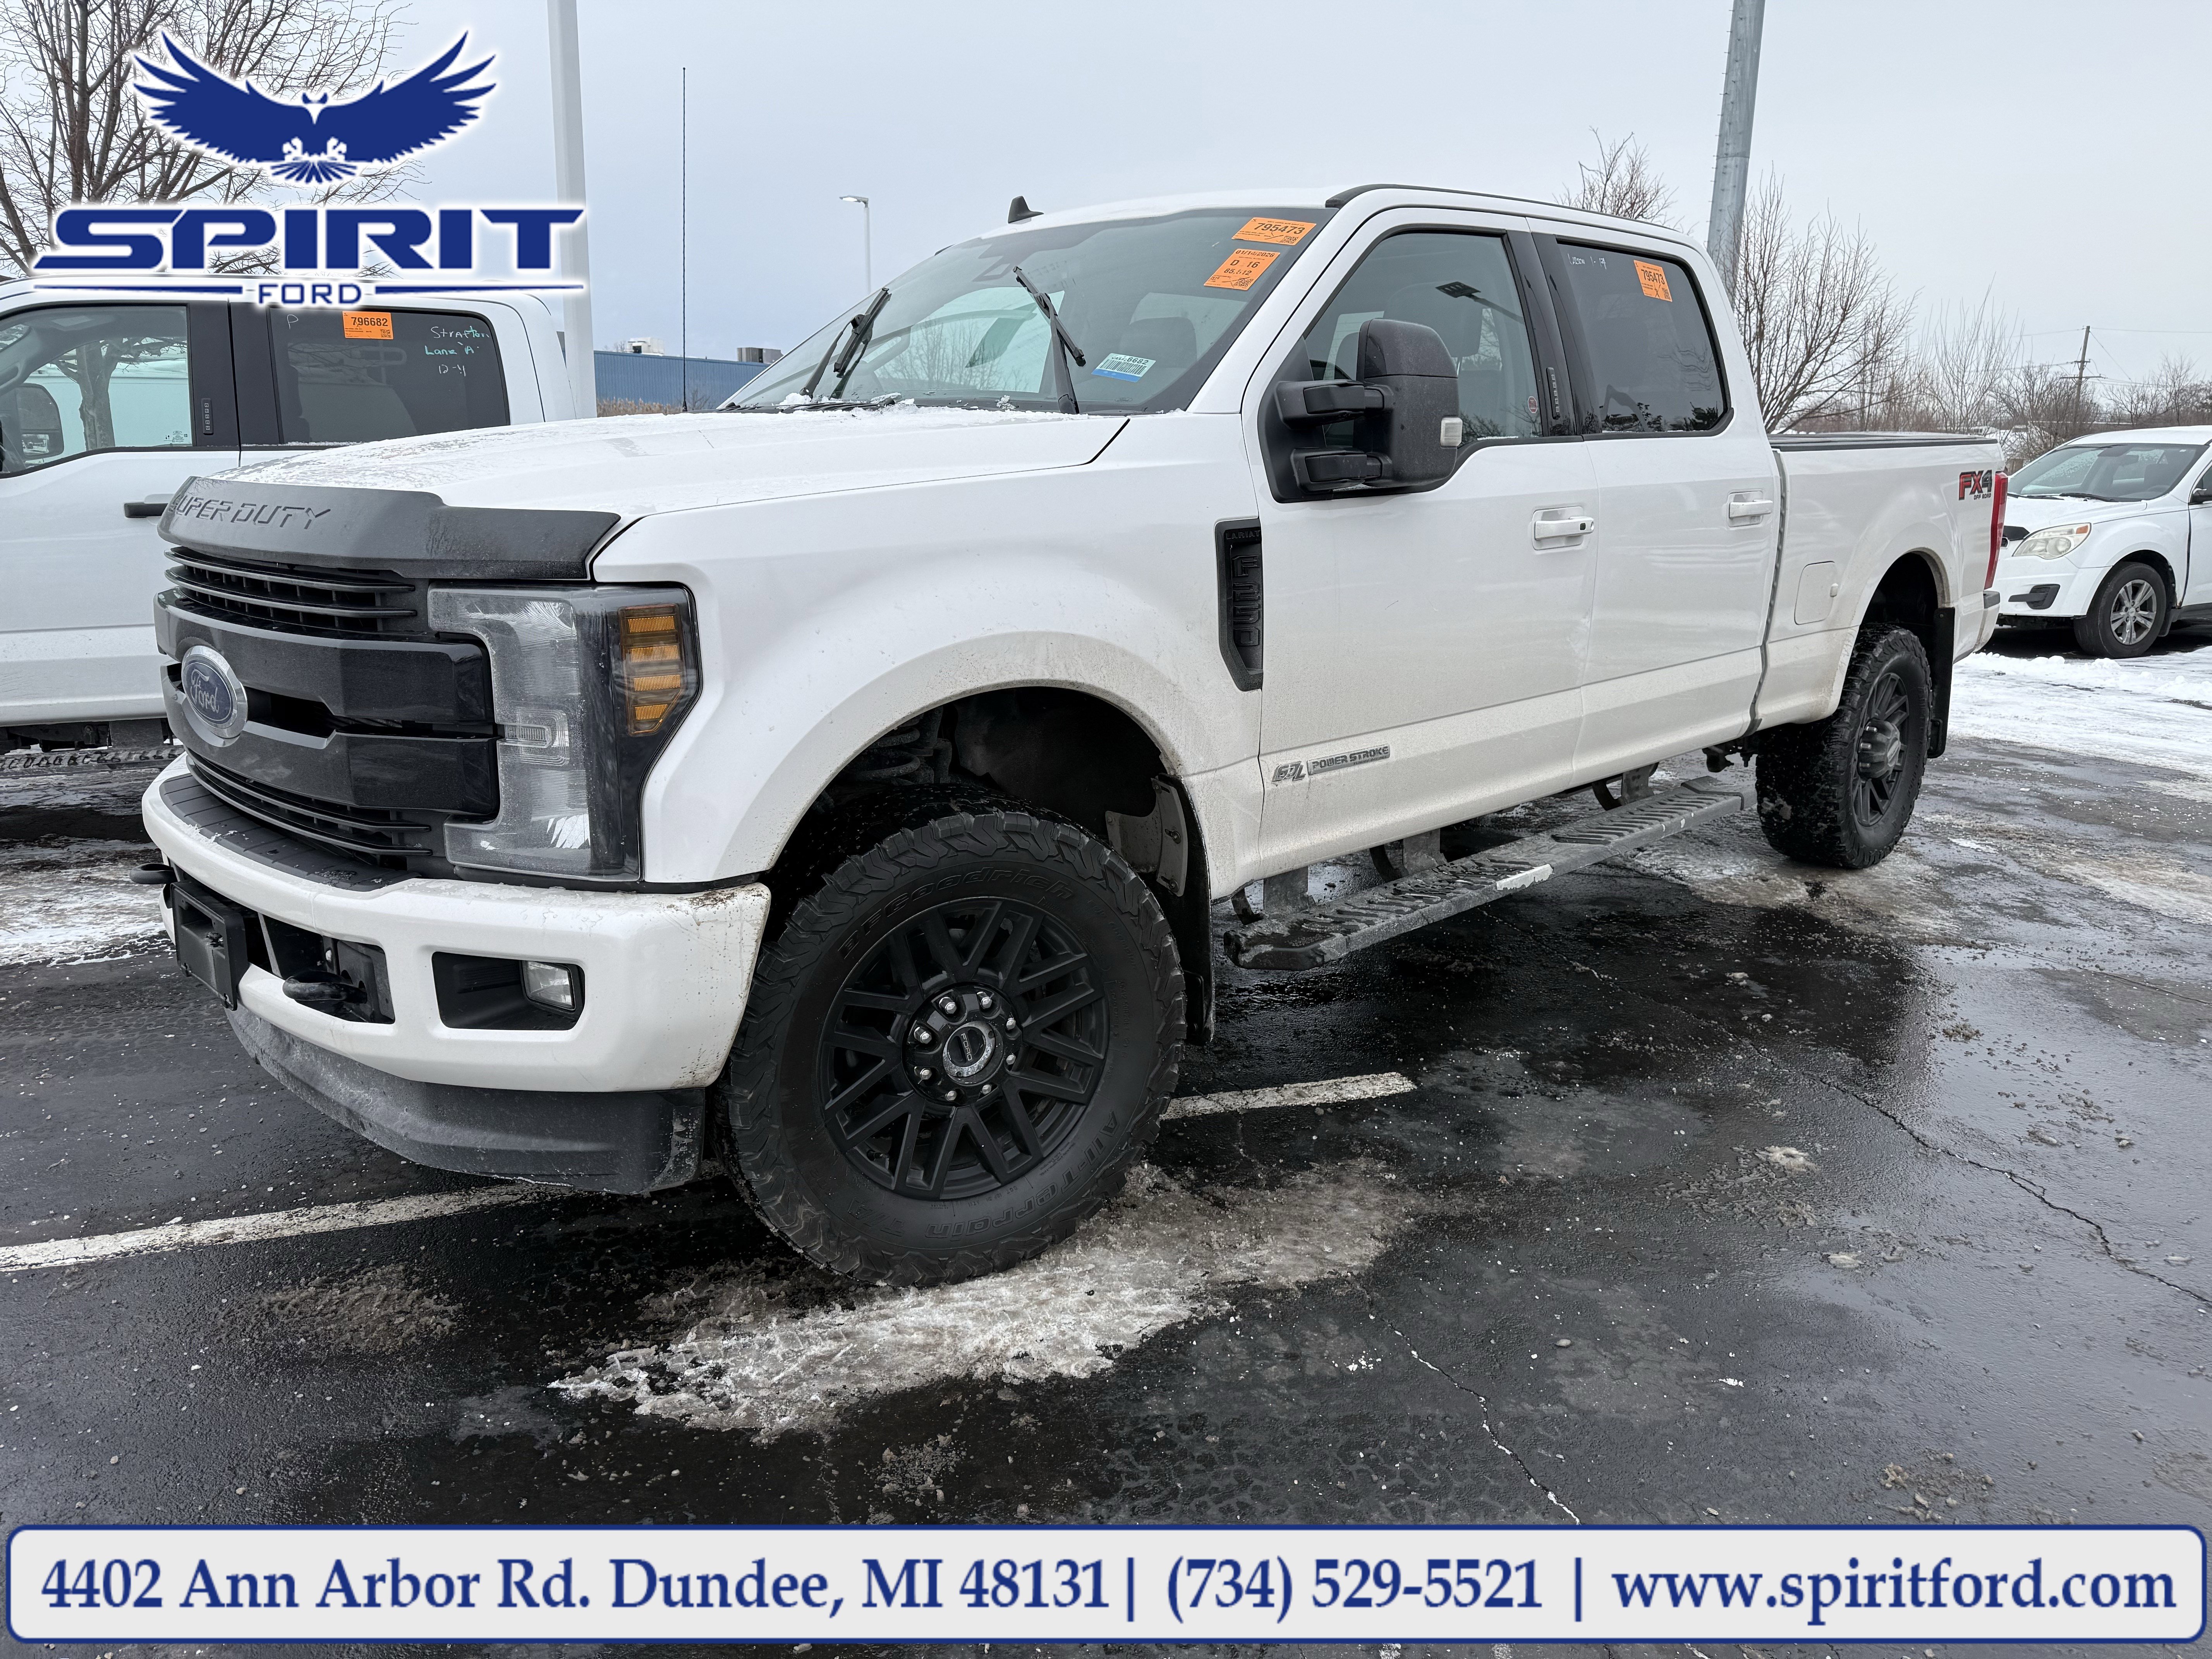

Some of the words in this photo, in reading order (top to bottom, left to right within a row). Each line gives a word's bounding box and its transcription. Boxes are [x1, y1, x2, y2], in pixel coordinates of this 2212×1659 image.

[1254, 223, 1305, 234] 795473
[1641, 269, 1665, 285] 795473
[351, 317, 388, 326] 796682
[424, 345, 457, 356] Lane
[1959, 469, 1992, 501] FX4
[231, 503, 331, 530] DUTY
[1226, 530, 1261, 540] LARIAT
[190, 668, 220, 713] Ford
[1312, 755, 1348, 769] POWER
[1349, 746, 1389, 762] STROKE
[961, 1033, 972, 1061] FORD
